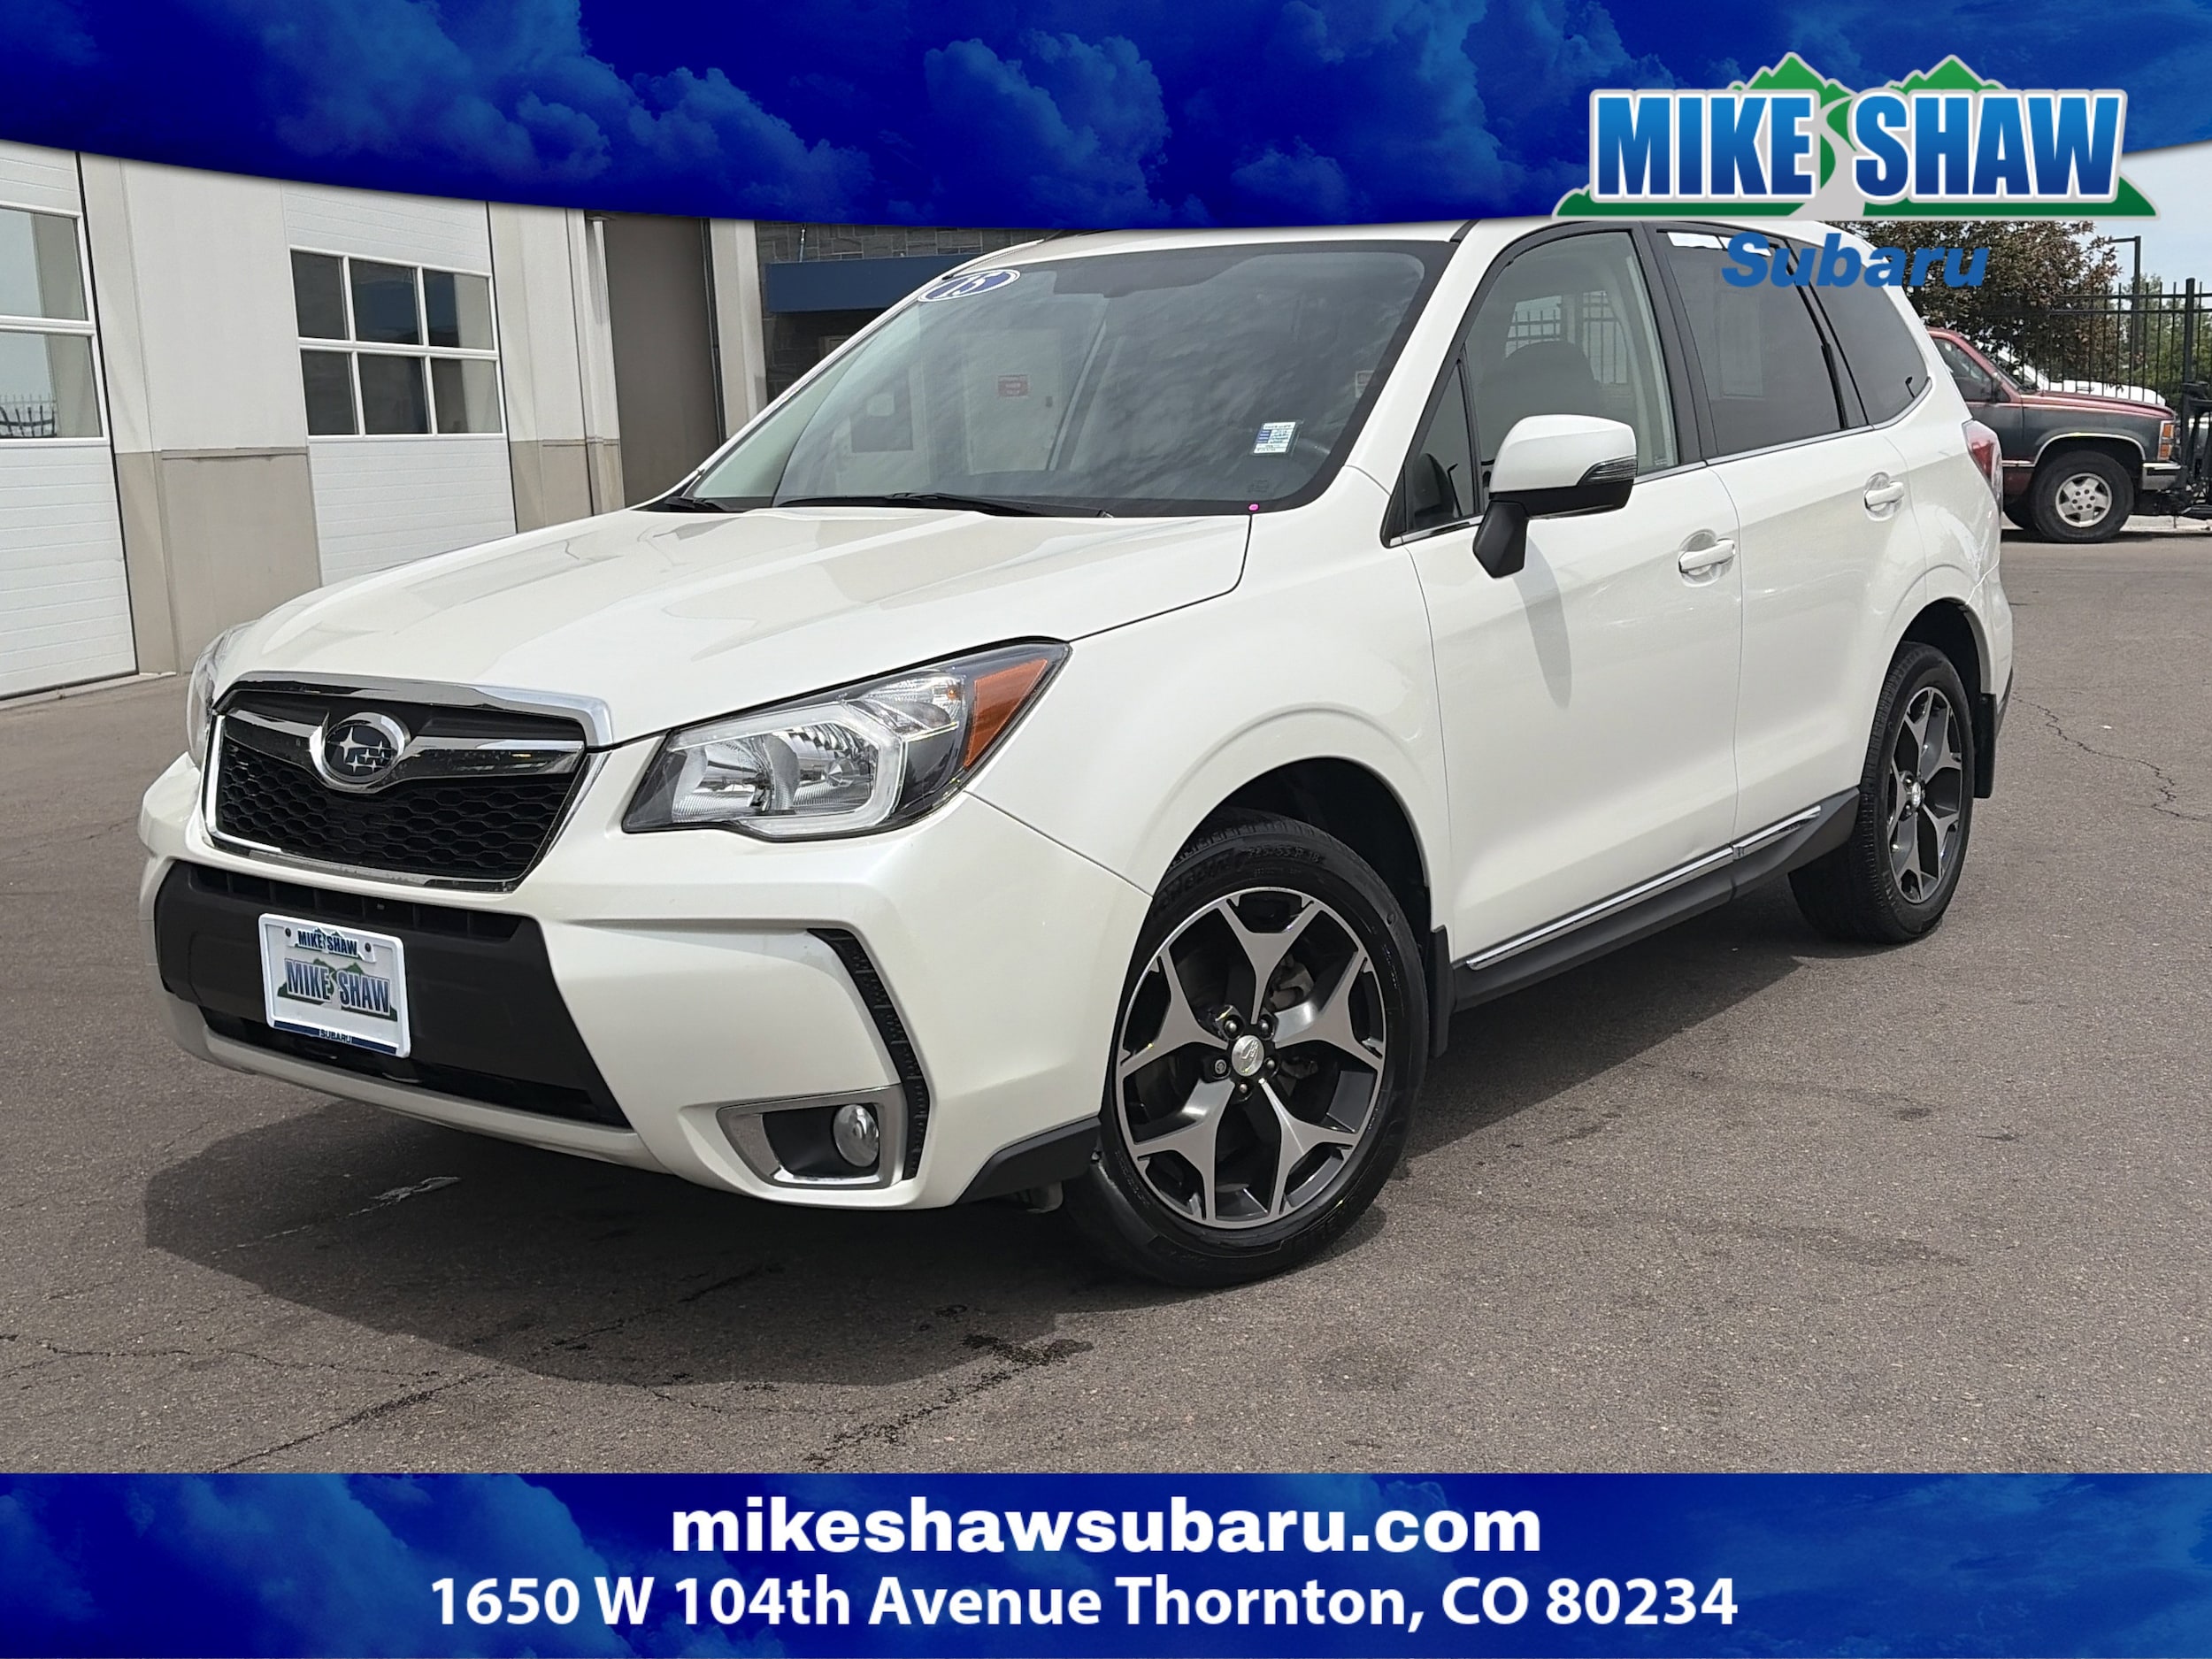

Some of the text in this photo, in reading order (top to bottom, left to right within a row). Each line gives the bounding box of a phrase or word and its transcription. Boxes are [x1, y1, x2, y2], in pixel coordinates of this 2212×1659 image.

[296, 930, 358, 956] MIKE SHAW
[285, 958, 391, 1015] MIKE SHAW
[319, 1028, 353, 1044] SUBARU
